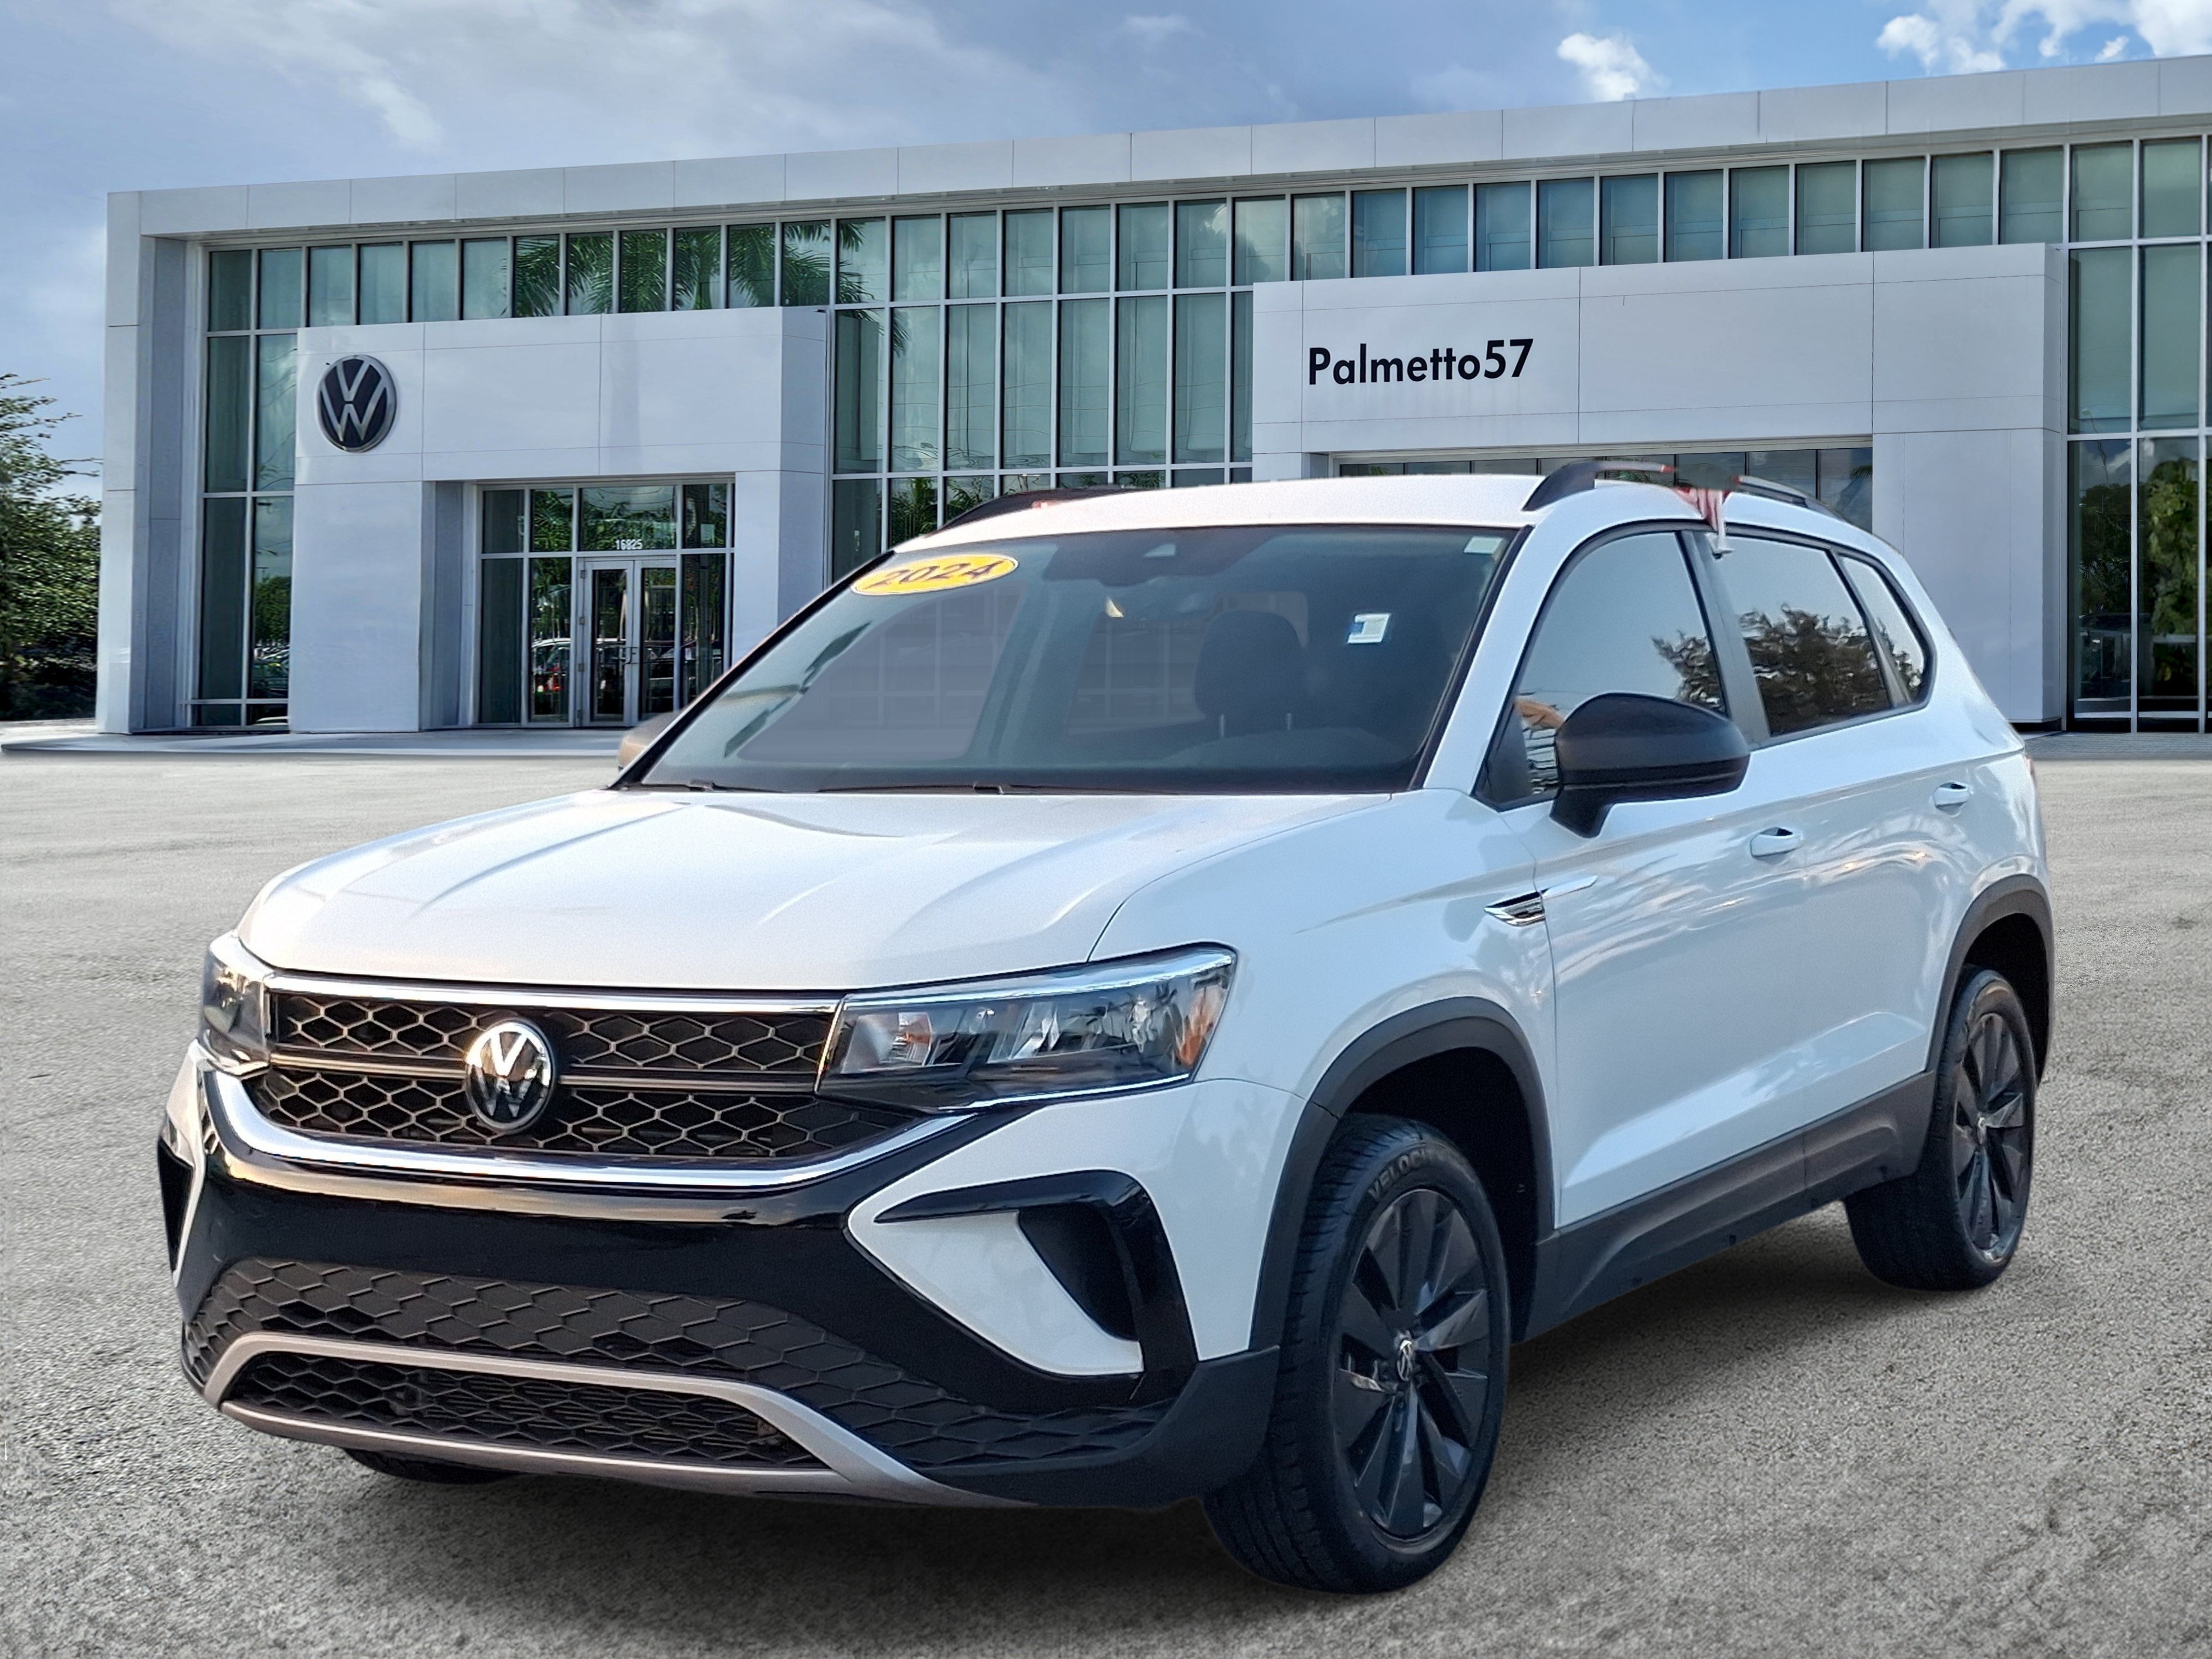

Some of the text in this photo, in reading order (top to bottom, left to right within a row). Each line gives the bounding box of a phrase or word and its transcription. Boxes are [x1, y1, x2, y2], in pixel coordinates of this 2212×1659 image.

[1309, 339, 1534, 385] Palmetto57
[319, 357, 390, 444] VW
[862, 558, 1005, 590] 2024
[471, 1026, 543, 1121] VW
